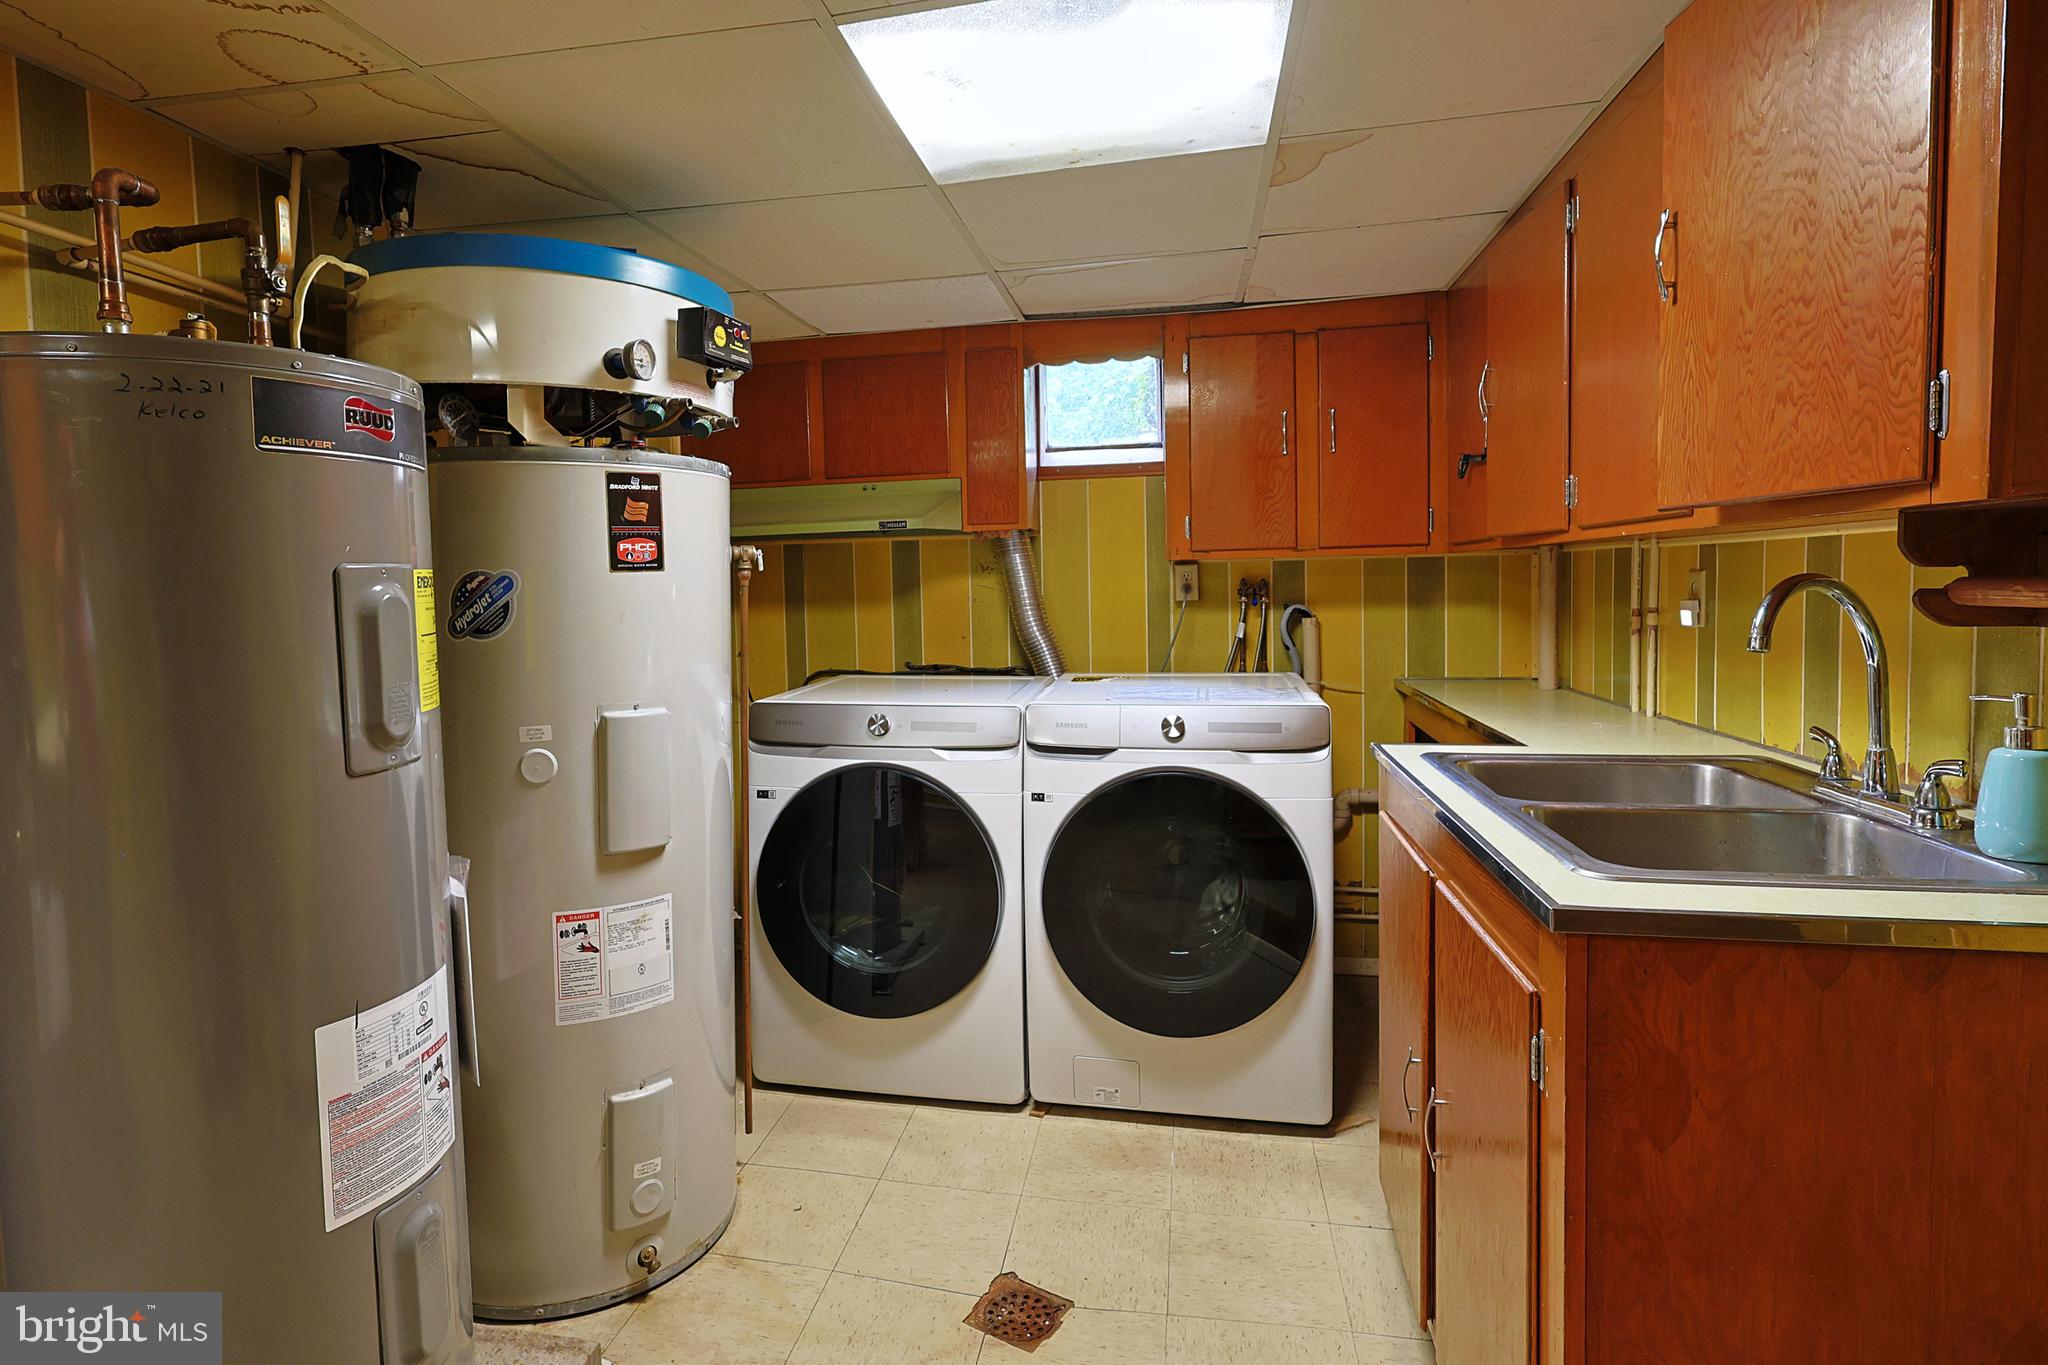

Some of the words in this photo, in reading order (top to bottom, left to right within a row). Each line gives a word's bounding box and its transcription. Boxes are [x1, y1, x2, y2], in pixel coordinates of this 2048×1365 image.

[114, 373, 225, 394] 2-22-21
[345, 408, 395, 431] RUUD
[260, 435, 333, 449] ACHIEVER
[609, 483, 641, 491] BRADFORD
[619, 543, 656, 551] PHCC
[454, 592, 492, 632] Hydrojet
[568, 913, 595, 921] DANGER
